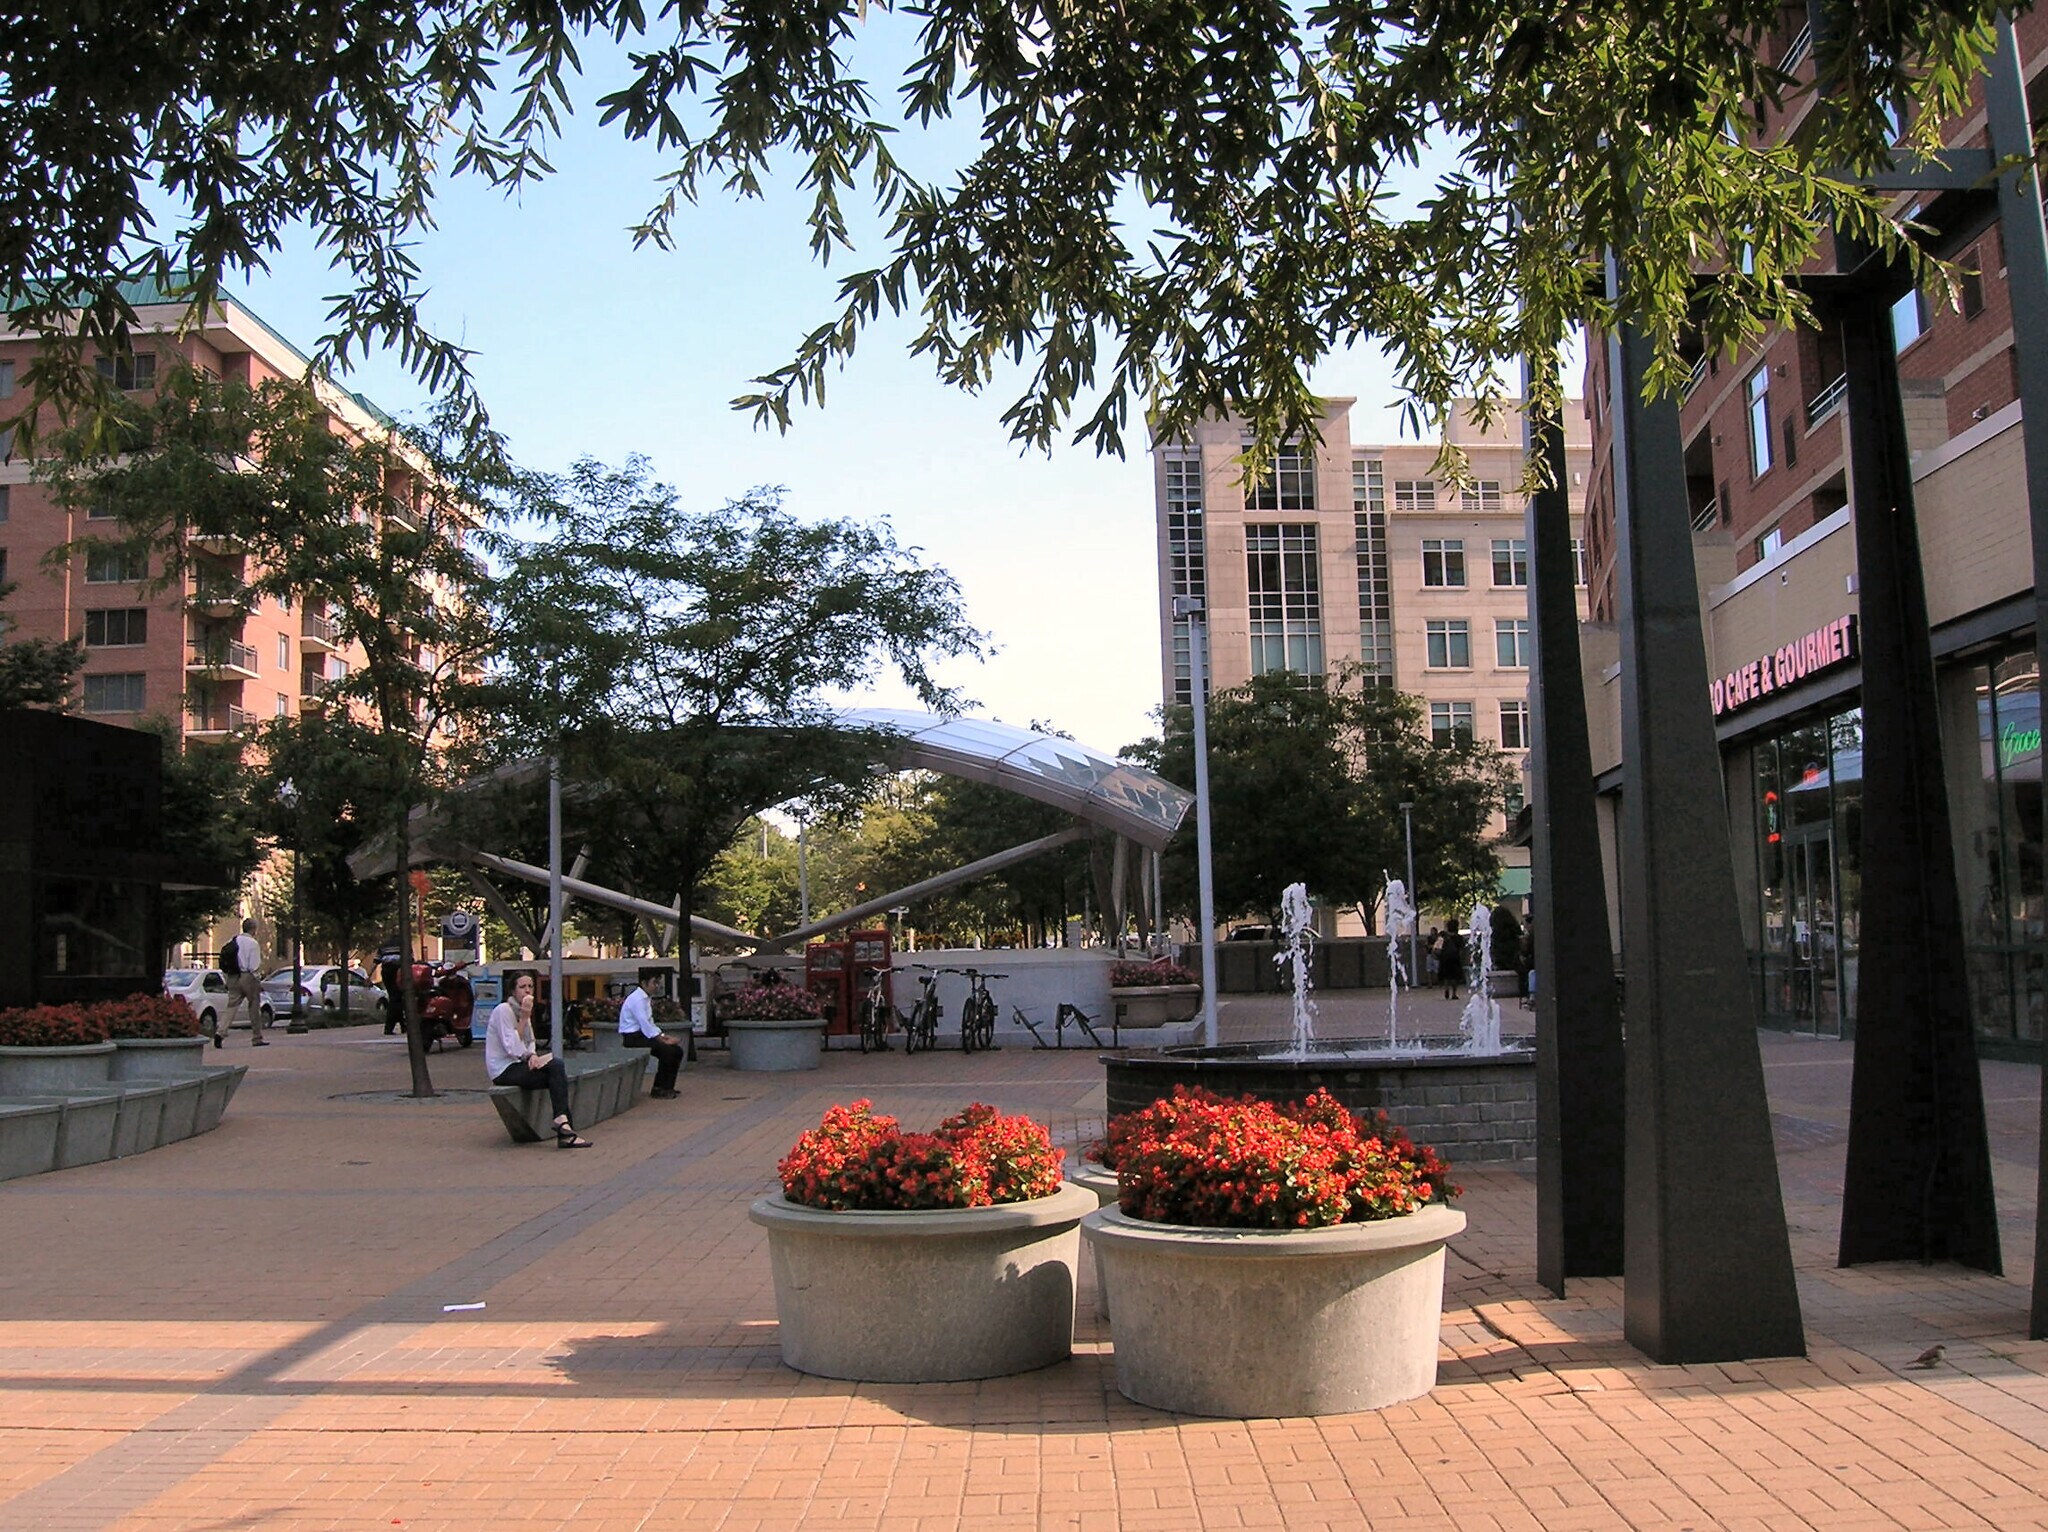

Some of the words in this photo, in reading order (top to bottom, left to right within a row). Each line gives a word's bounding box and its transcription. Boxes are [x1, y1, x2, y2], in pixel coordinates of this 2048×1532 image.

[1725, 660, 1760, 710] CAFE
[1761, 655, 1774, 694] &
[1774, 614, 1851, 688] GOURMET
